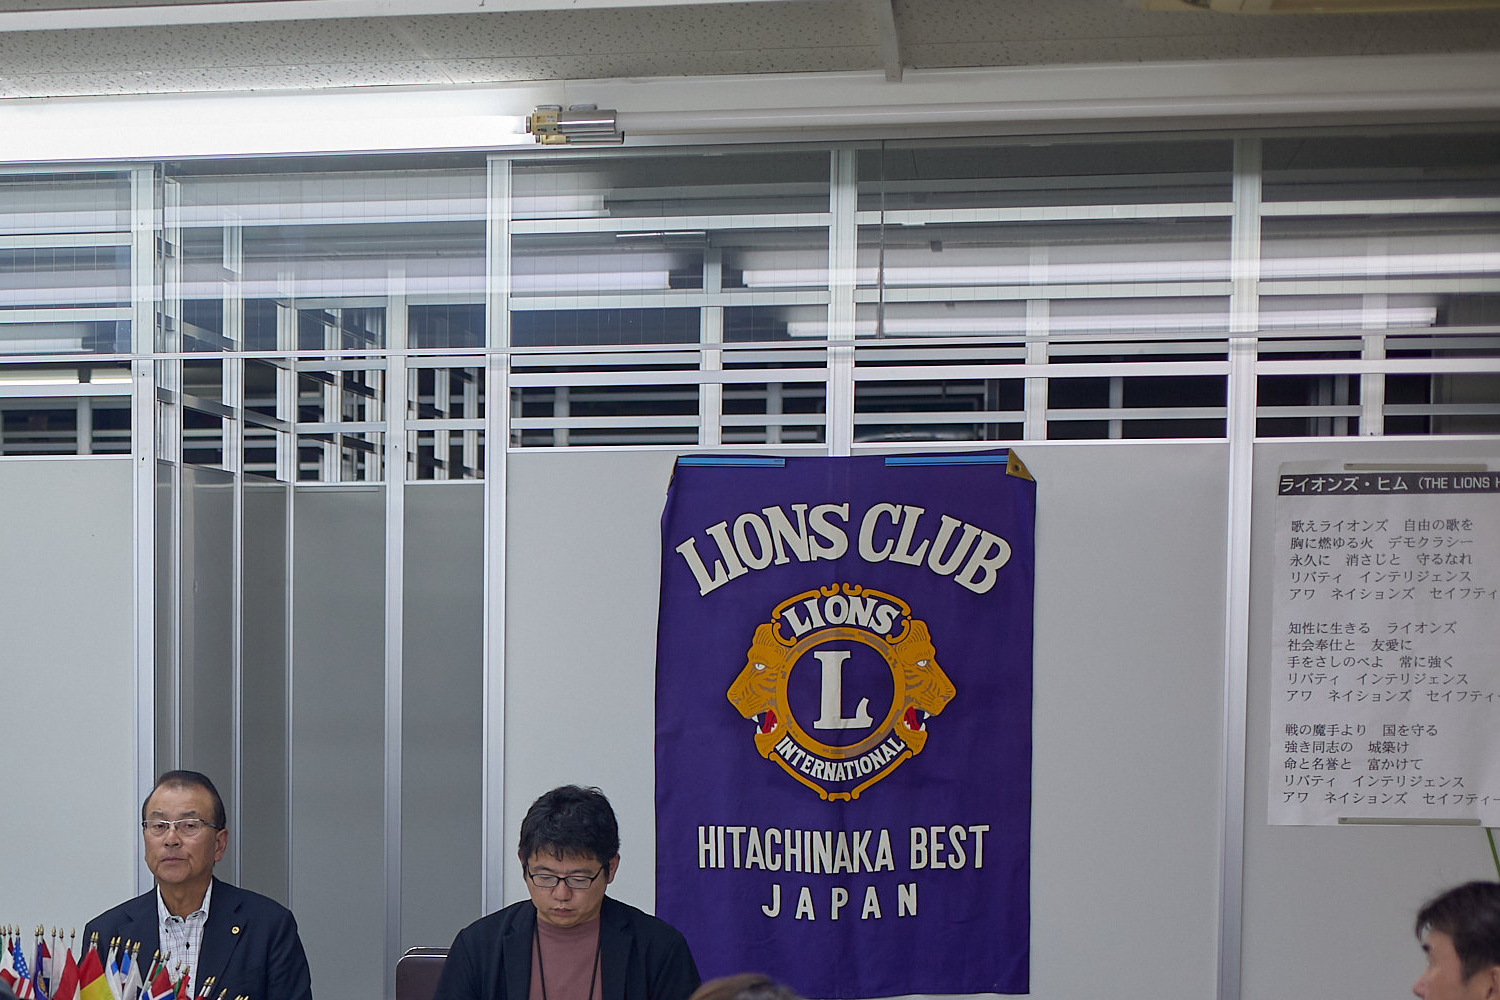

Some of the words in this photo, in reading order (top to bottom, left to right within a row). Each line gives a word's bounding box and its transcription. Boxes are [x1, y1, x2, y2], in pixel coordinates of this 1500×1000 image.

[1281, 477, 1408, 492] ライオンズ・ヒム
[1454, 477, 1490, 489] LIONS
[1291, 518, 1389, 533] 歌えライオンズ
[1404, 518, 1473, 532] 自由の歌を
[675, 502, 850, 597] LIONS
[858, 502, 1012, 594] CLUB
[1289, 536, 1374, 550] 胸に燃ゆる火
[1388, 535, 1473, 550] デモクラシー
[1289, 553, 1331, 567] 永久に
[1345, 553, 1401, 567] 消さじと
[1416, 552, 1472, 566] 守るなれ
[1291, 571, 1342, 584] リバティ
[1359, 570, 1472, 584] インテリジェンス
[1289, 588, 1316, 601] アワ
[1330, 586, 1416, 601] ネイションズ
[782, 594, 901, 637] LIONS
[1287, 621, 1371, 635] 知性に生きる
[1387, 621, 1458, 635] ライオンズ
[1287, 638, 1356, 652] 社会奉仕と
[1371, 638, 1412, 652] 友愛に
[1287, 655, 1384, 669] 手をさしのべよ
[1399, 655, 1453, 669] 常に強く
[1288, 672, 1339, 686] リバティ
[1356, 672, 1469, 686] インテリジェンス
[813, 650, 874, 730] L
[1286, 690, 1313, 702] アワ
[1328, 688, 1413, 703] ネイションズ
[1426, 690, 1500, 703] セイフティ
[1285, 723, 1366, 737] 戦の魔手より
[1382, 723, 1438, 737] 国を守る
[1284, 739, 1354, 754] 強き同志の
[1367, 740, 1410, 755] 城築け
[775, 736, 906, 782] INTERNATIONAL
[1283, 756, 1352, 771] 命と名誉と
[1367, 757, 1423, 771] 富かけて
[1285, 774, 1336, 788] リバティ
[1352, 775, 1465, 788] インテリジェンス
[1283, 791, 1309, 804] アワ
[1324, 791, 1409, 805] ネイションズ
[697, 825, 895, 874] HITACHINAKA
[910, 824, 990, 871] BEST
[761, 882, 919, 920] JAPAN
